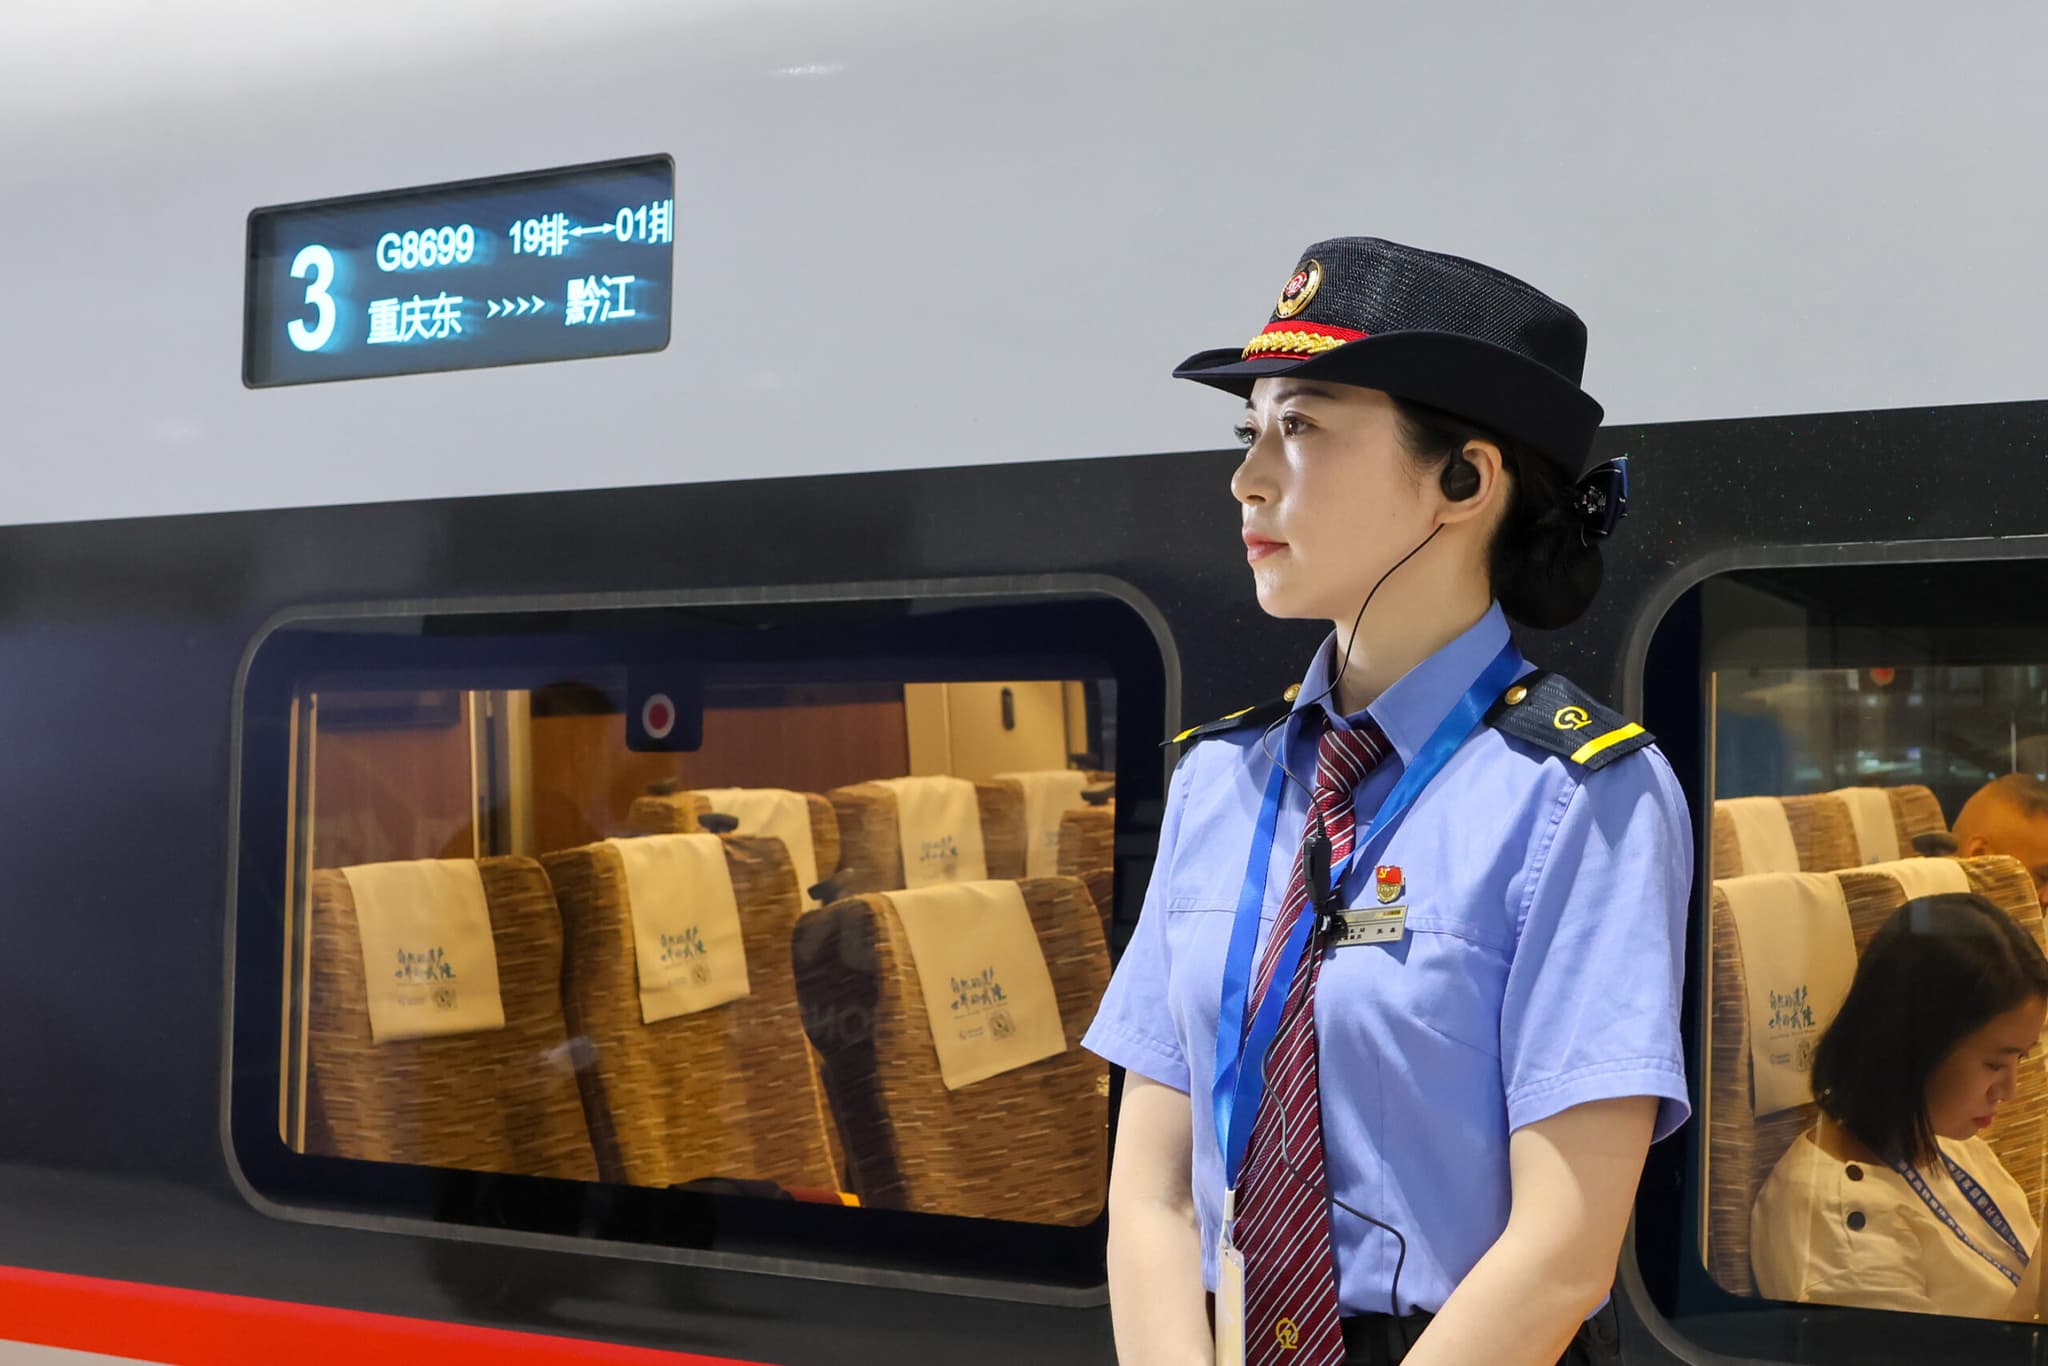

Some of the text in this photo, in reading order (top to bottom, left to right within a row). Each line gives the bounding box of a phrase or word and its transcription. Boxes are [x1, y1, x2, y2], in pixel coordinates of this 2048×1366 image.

[375, 223, 476, 272] G8699
[508, 212, 569, 257] 19排
[287, 243, 337, 353] 3
[366, 274, 636, 345] 重庆东 黔江
